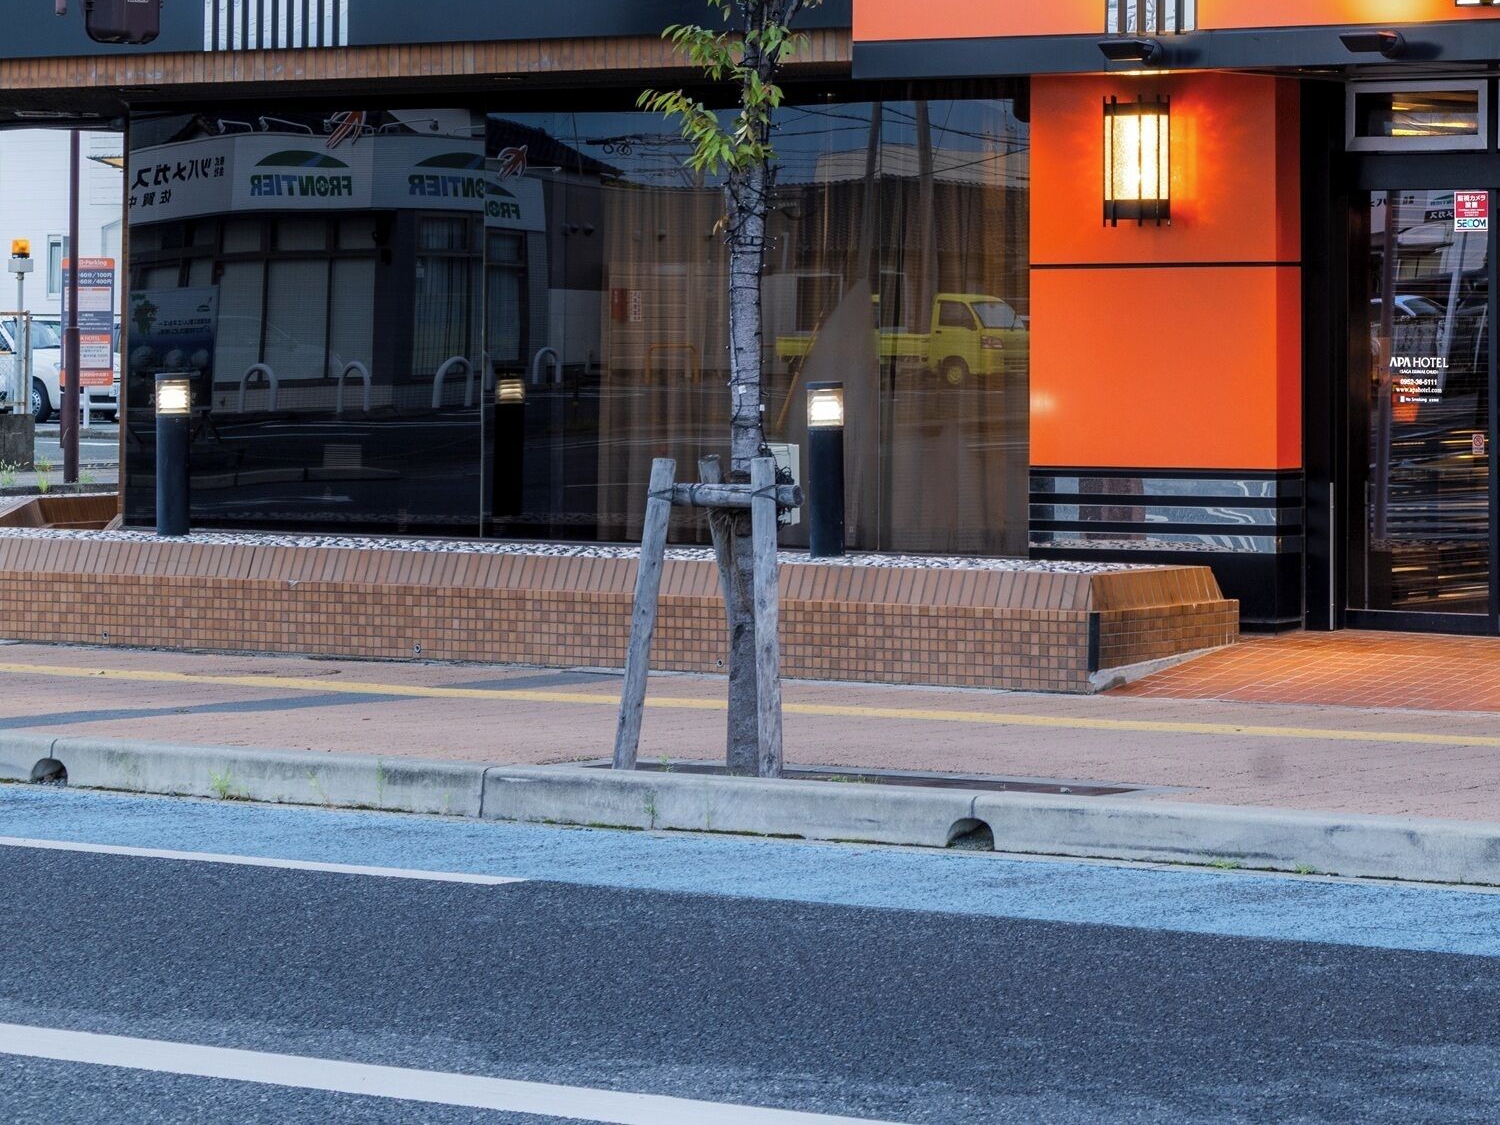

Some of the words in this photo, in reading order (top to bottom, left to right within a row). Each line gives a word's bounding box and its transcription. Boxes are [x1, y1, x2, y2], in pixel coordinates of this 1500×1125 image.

[1456, 218, 1487, 228] SECOM
[1389, 356, 1412, 368] APA
[1412, 356, 1449, 368] HOTEL
